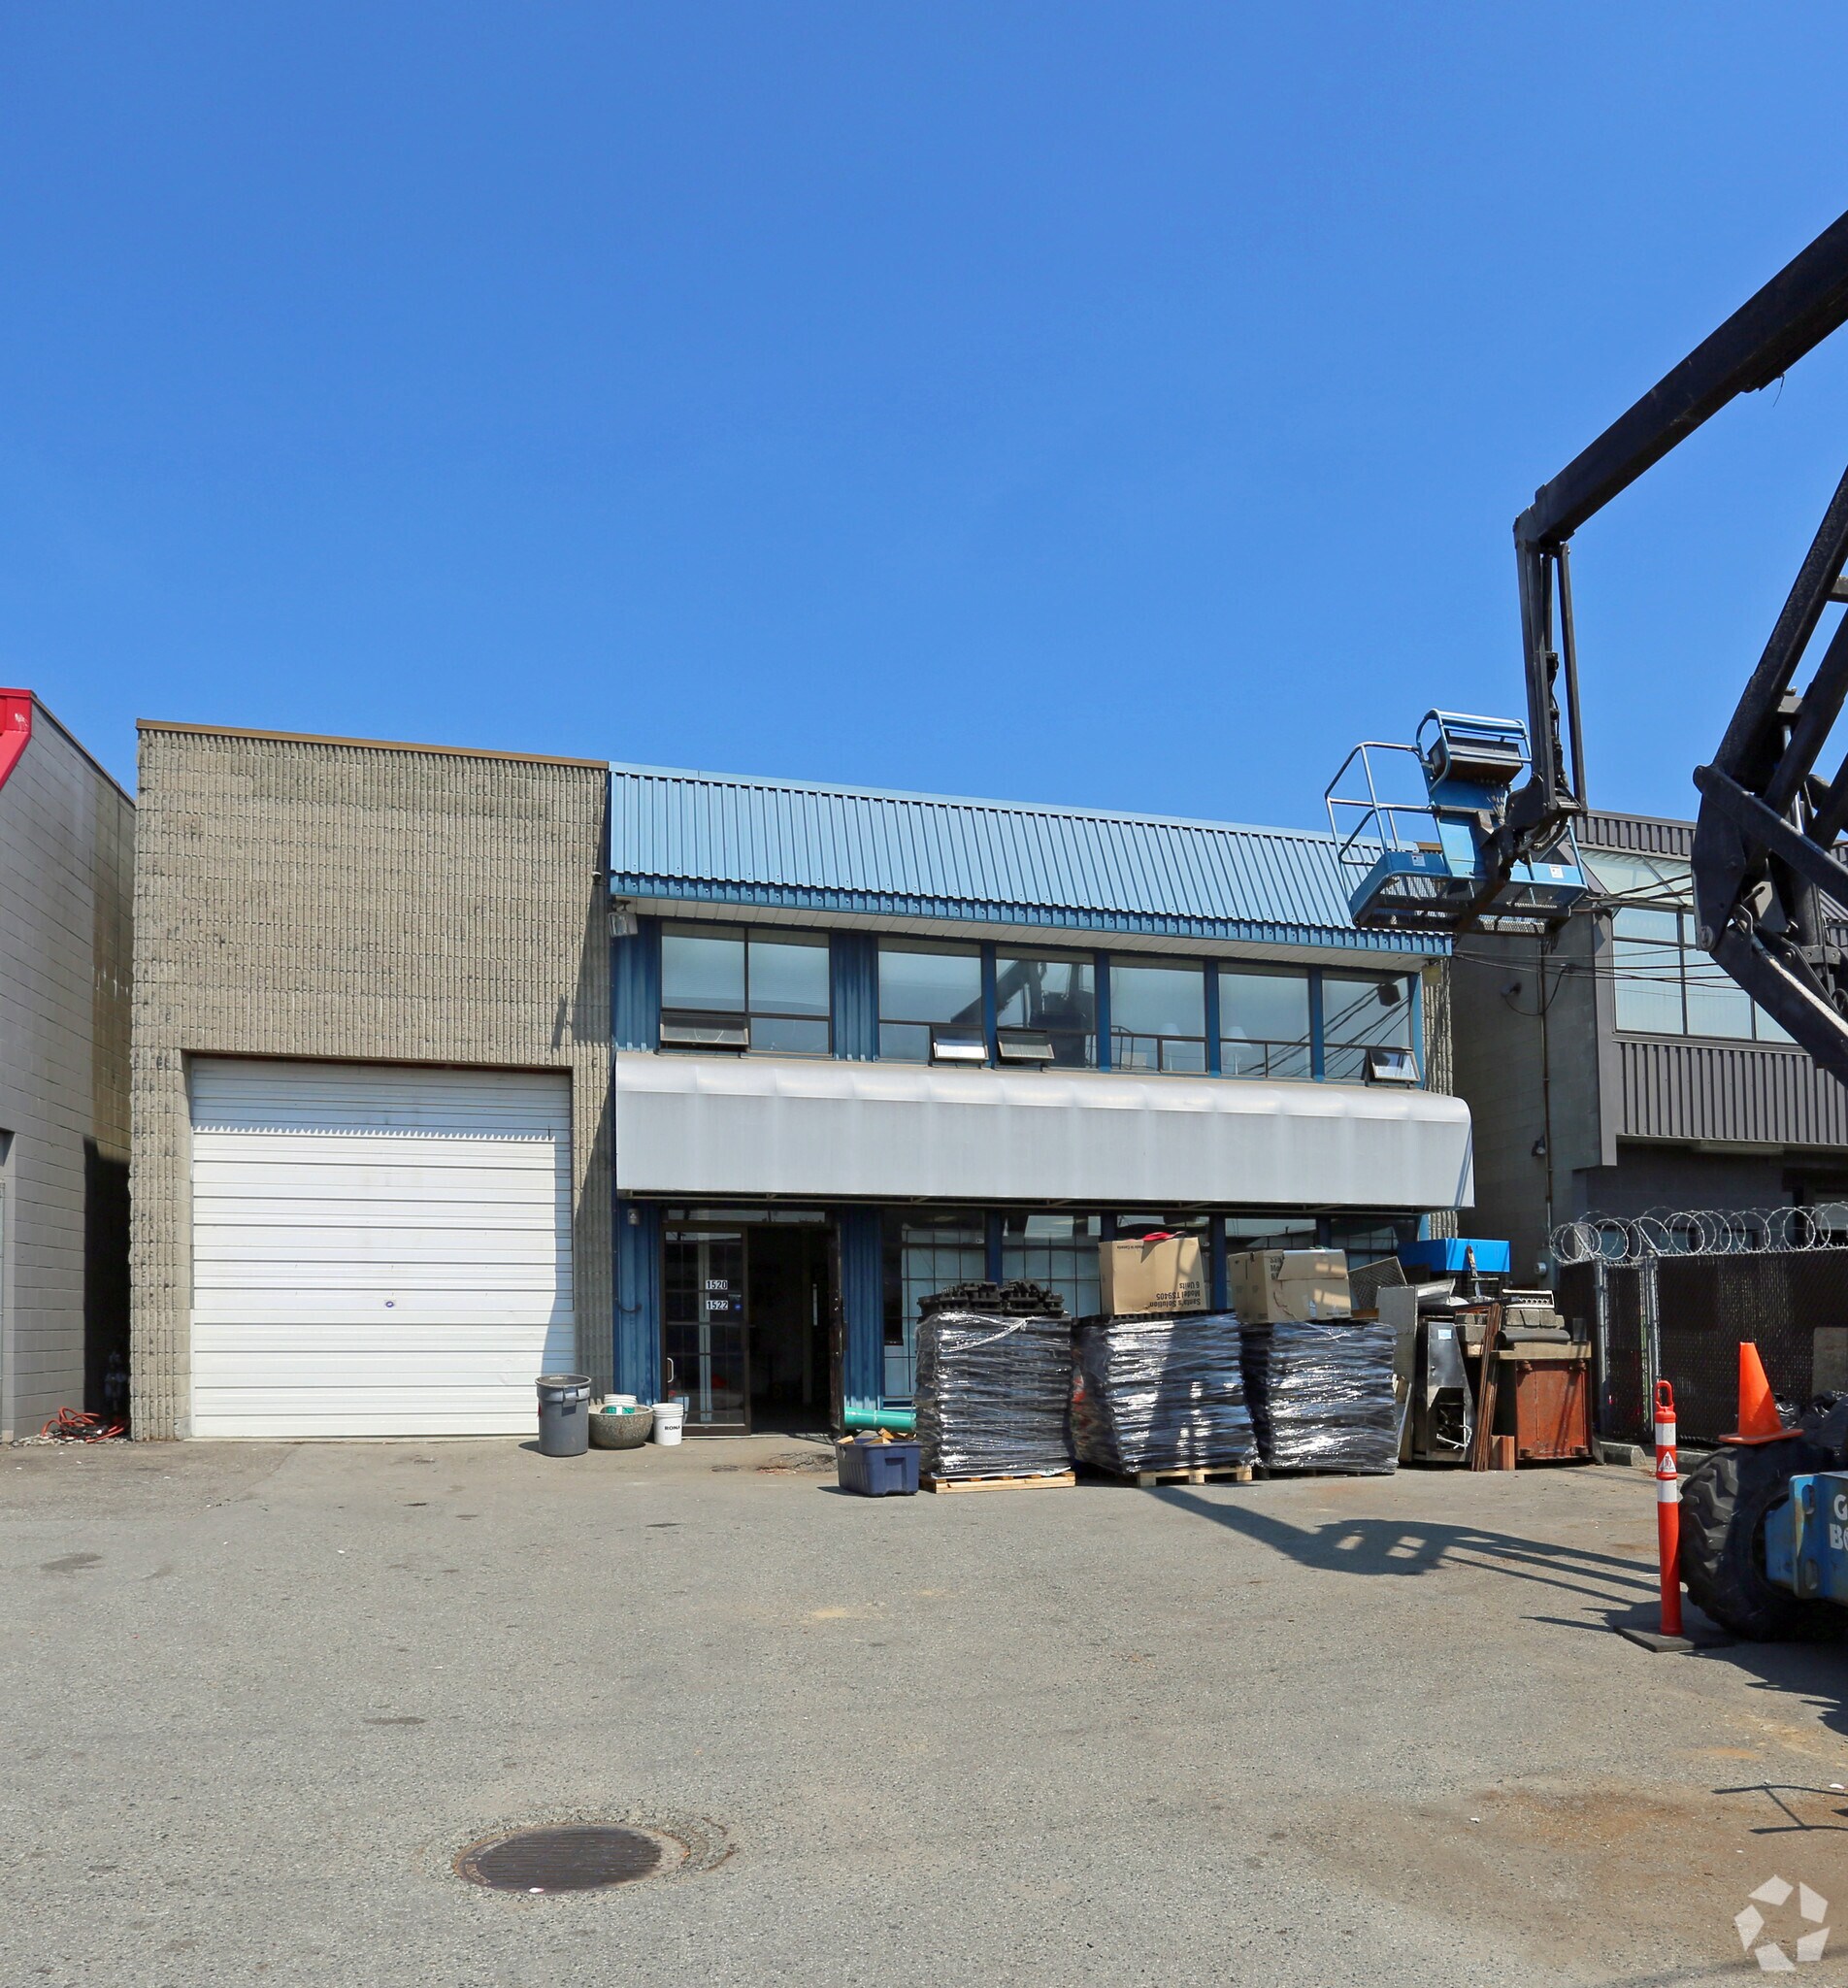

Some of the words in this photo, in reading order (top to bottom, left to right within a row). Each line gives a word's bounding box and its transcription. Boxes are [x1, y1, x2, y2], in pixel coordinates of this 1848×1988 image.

[707, 1280, 728, 1289] 1520
[1195, 1280, 1201, 1289] 6
[707, 1301, 728, 1309] 1522
